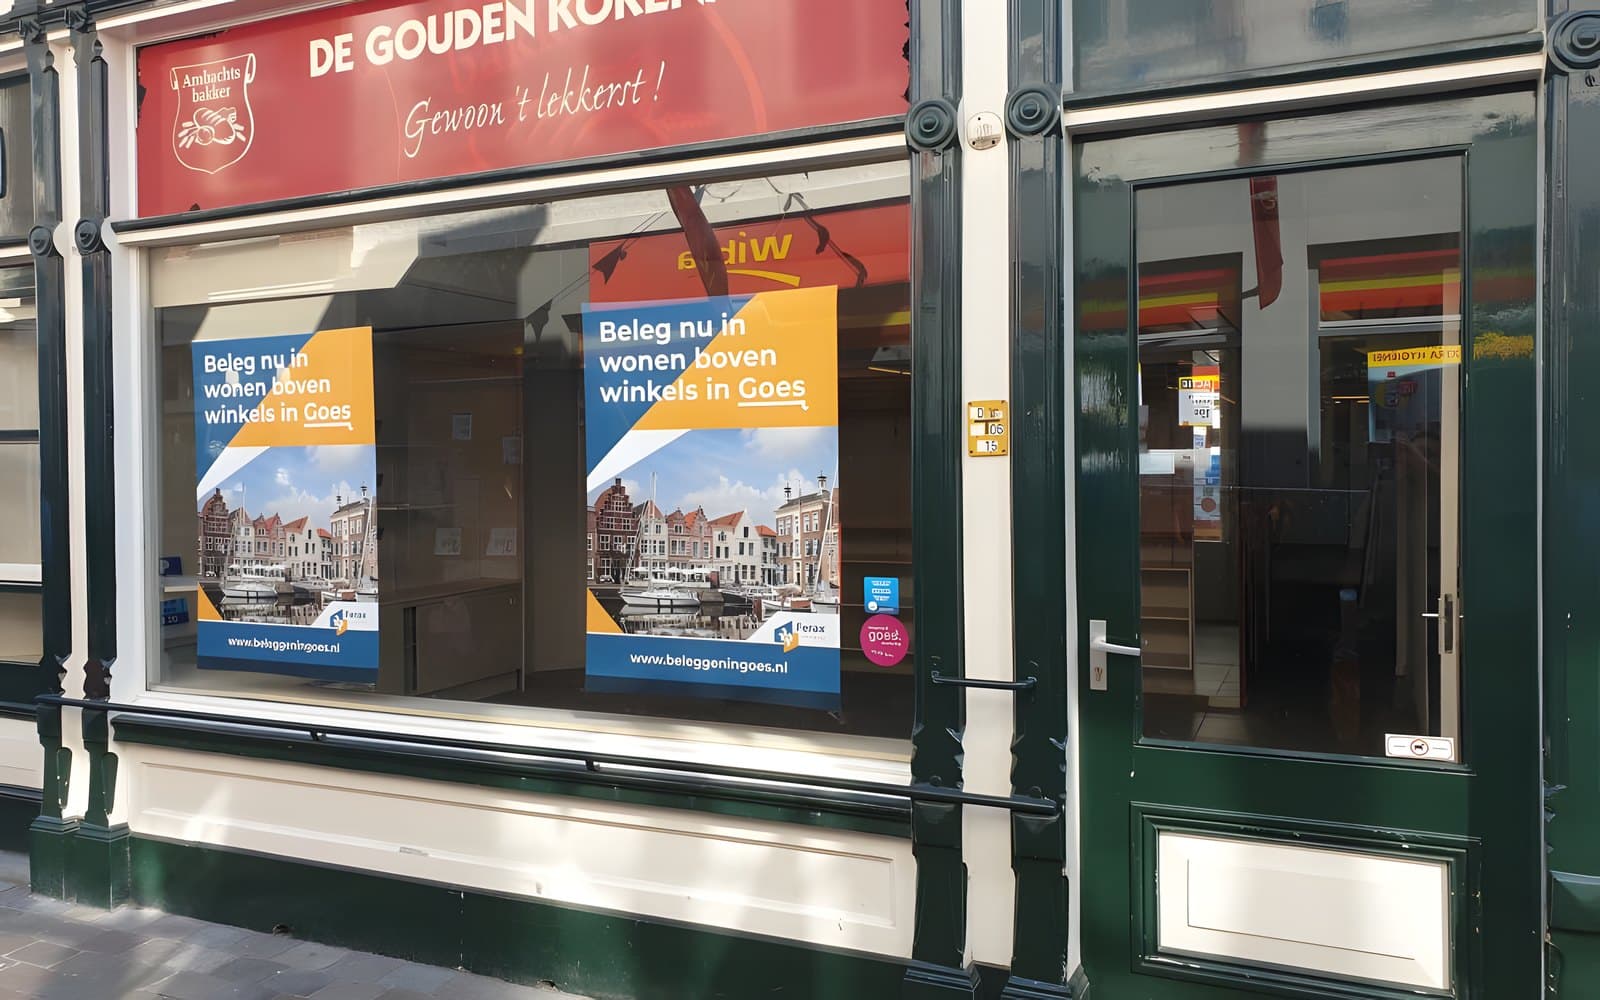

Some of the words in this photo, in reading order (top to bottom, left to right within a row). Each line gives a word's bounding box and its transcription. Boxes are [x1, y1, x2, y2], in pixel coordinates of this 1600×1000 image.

[309, 33, 354, 78] DE
[365, 0, 536, 66] GOUDEN
[182, 66, 241, 89] Ambachts
[192, 86, 231, 103] bakker
[404, 97, 505, 159] Gewoon
[599, 318, 671, 345] Beleg
[679, 318, 713, 339] nu
[721, 312, 746, 336] in
[204, 352, 255, 375] Beleg
[260, 354, 285, 370] nu
[290, 347, 308, 368] in
[599, 353, 686, 373] wonen
[695, 346, 777, 369] boven
[204, 381, 266, 399] wonen
[271, 376, 331, 396] boven
[599, 379, 699, 403] winkels
[706, 376, 730, 400] in
[738, 378, 807, 399] Goes
[204, 404, 276, 425] winkels
[280, 402, 299, 422] in
[303, 402, 352, 421] Goes
[985, 440, 998, 452] 15
